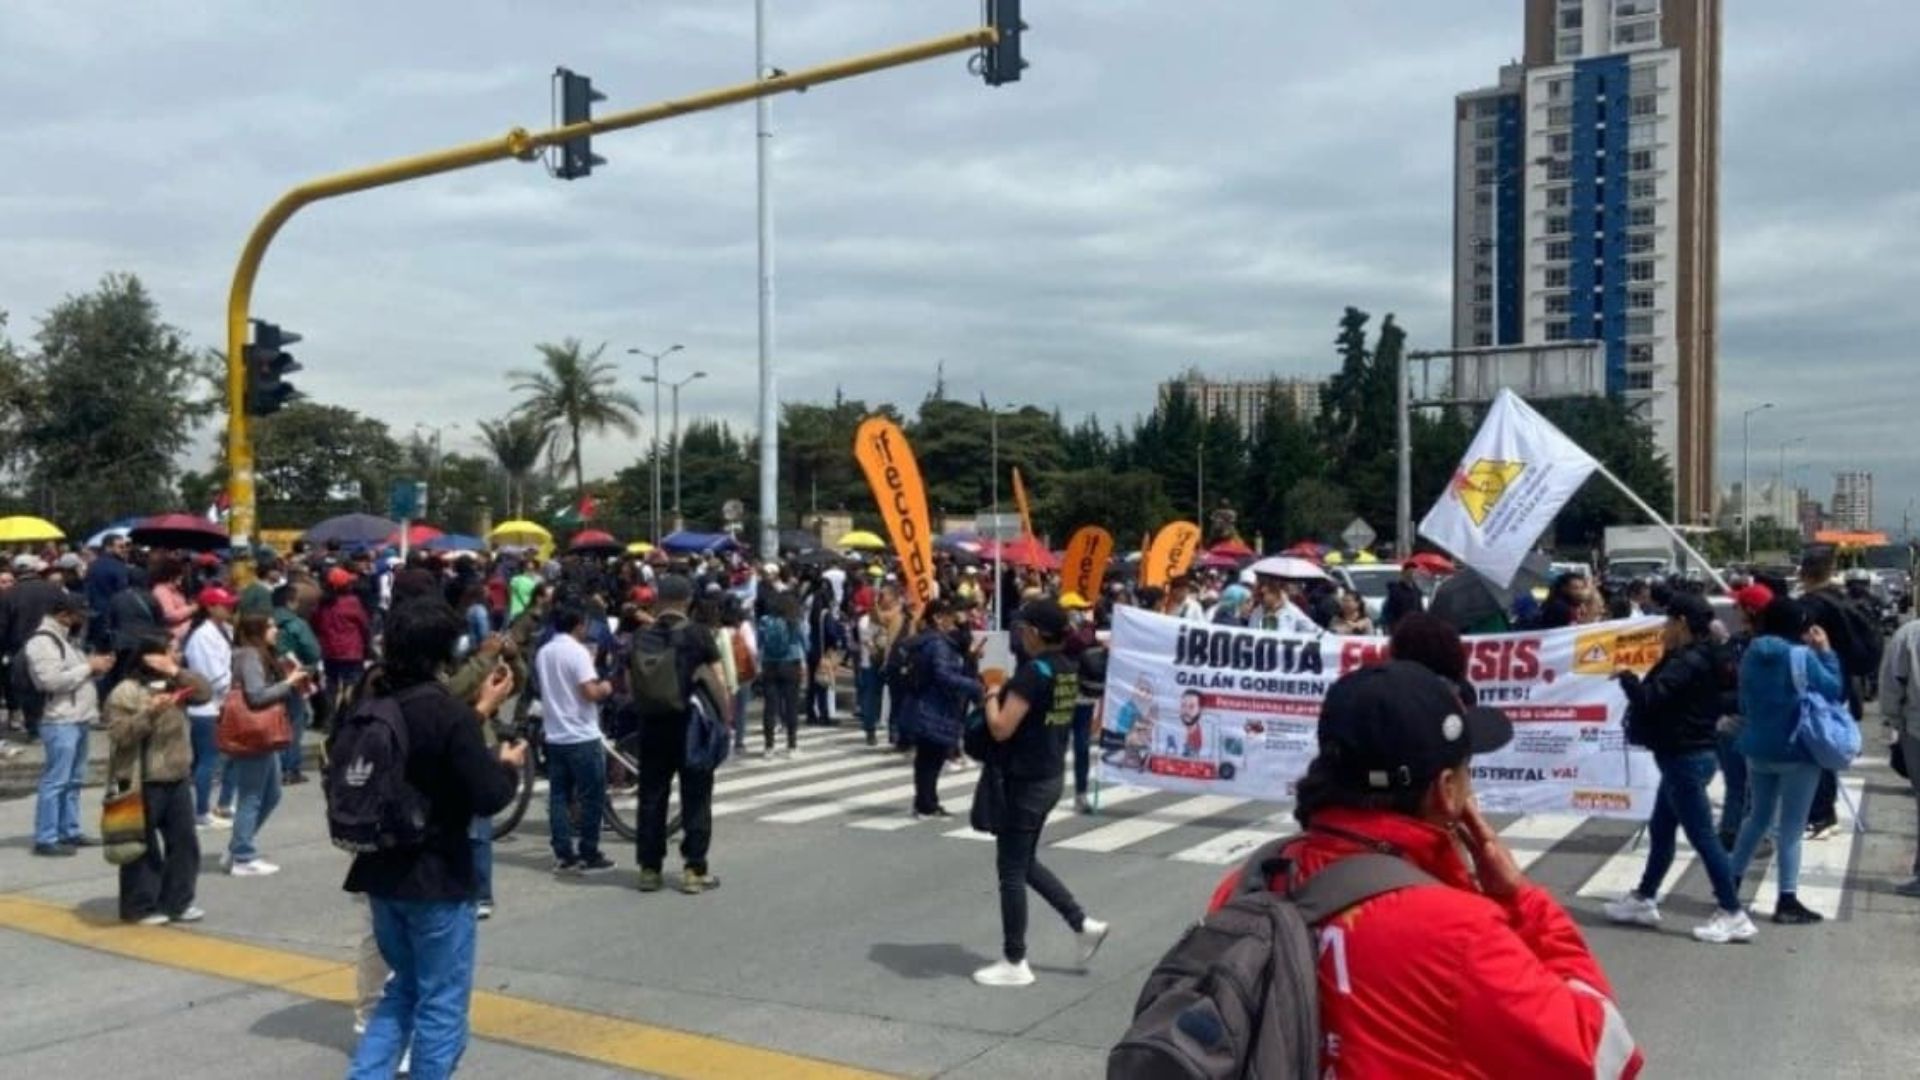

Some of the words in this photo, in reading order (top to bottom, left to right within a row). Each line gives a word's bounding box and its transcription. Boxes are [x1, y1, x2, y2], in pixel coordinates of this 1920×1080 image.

[1458, 638, 1556, 684] SIS.
[1176, 671, 1234, 689] GALÁN
[1239, 676, 1325, 696] GOBIERN
[1479, 686, 1530, 701] ITES!
[1468, 766, 1546, 782] ISTRITAL
